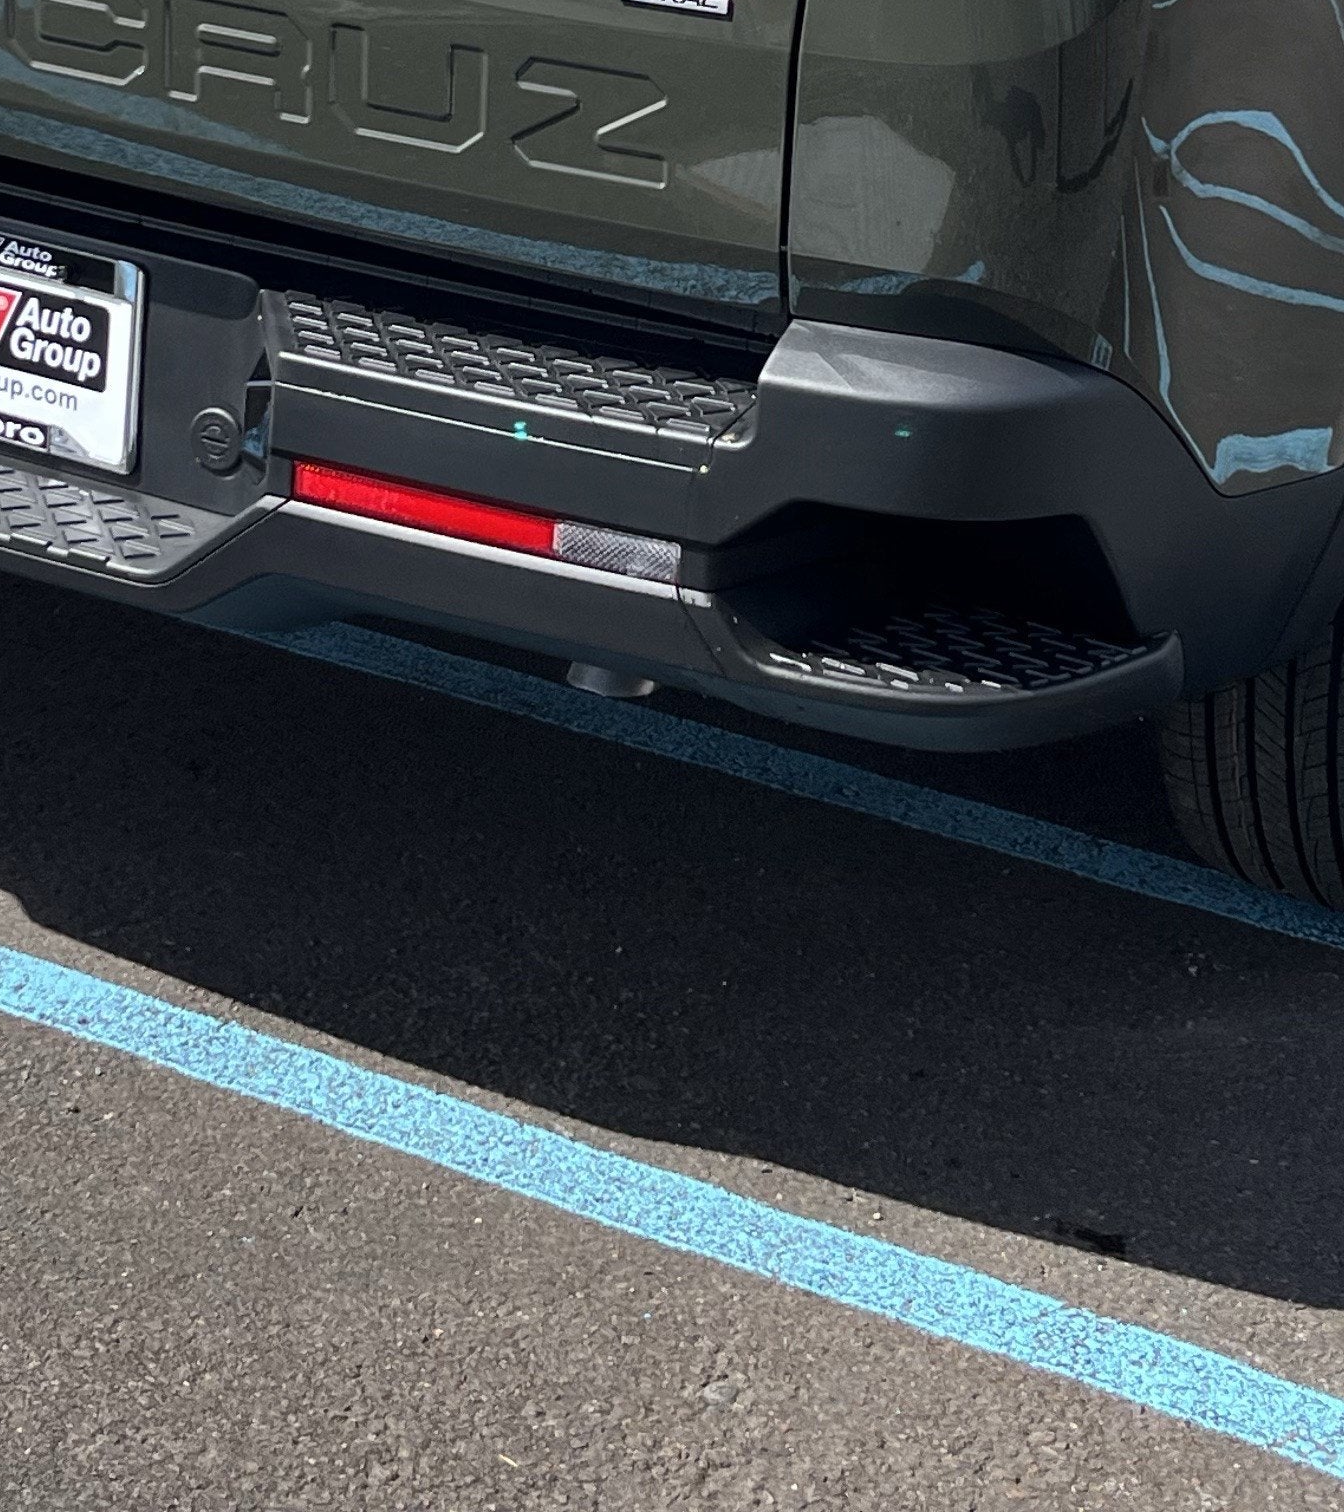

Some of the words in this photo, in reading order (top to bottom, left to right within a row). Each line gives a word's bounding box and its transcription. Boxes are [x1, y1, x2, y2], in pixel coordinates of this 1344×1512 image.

[4, 240, 53, 264] Auto
[16, 297, 92, 343] Auto
[9, 330, 102, 383] Group
